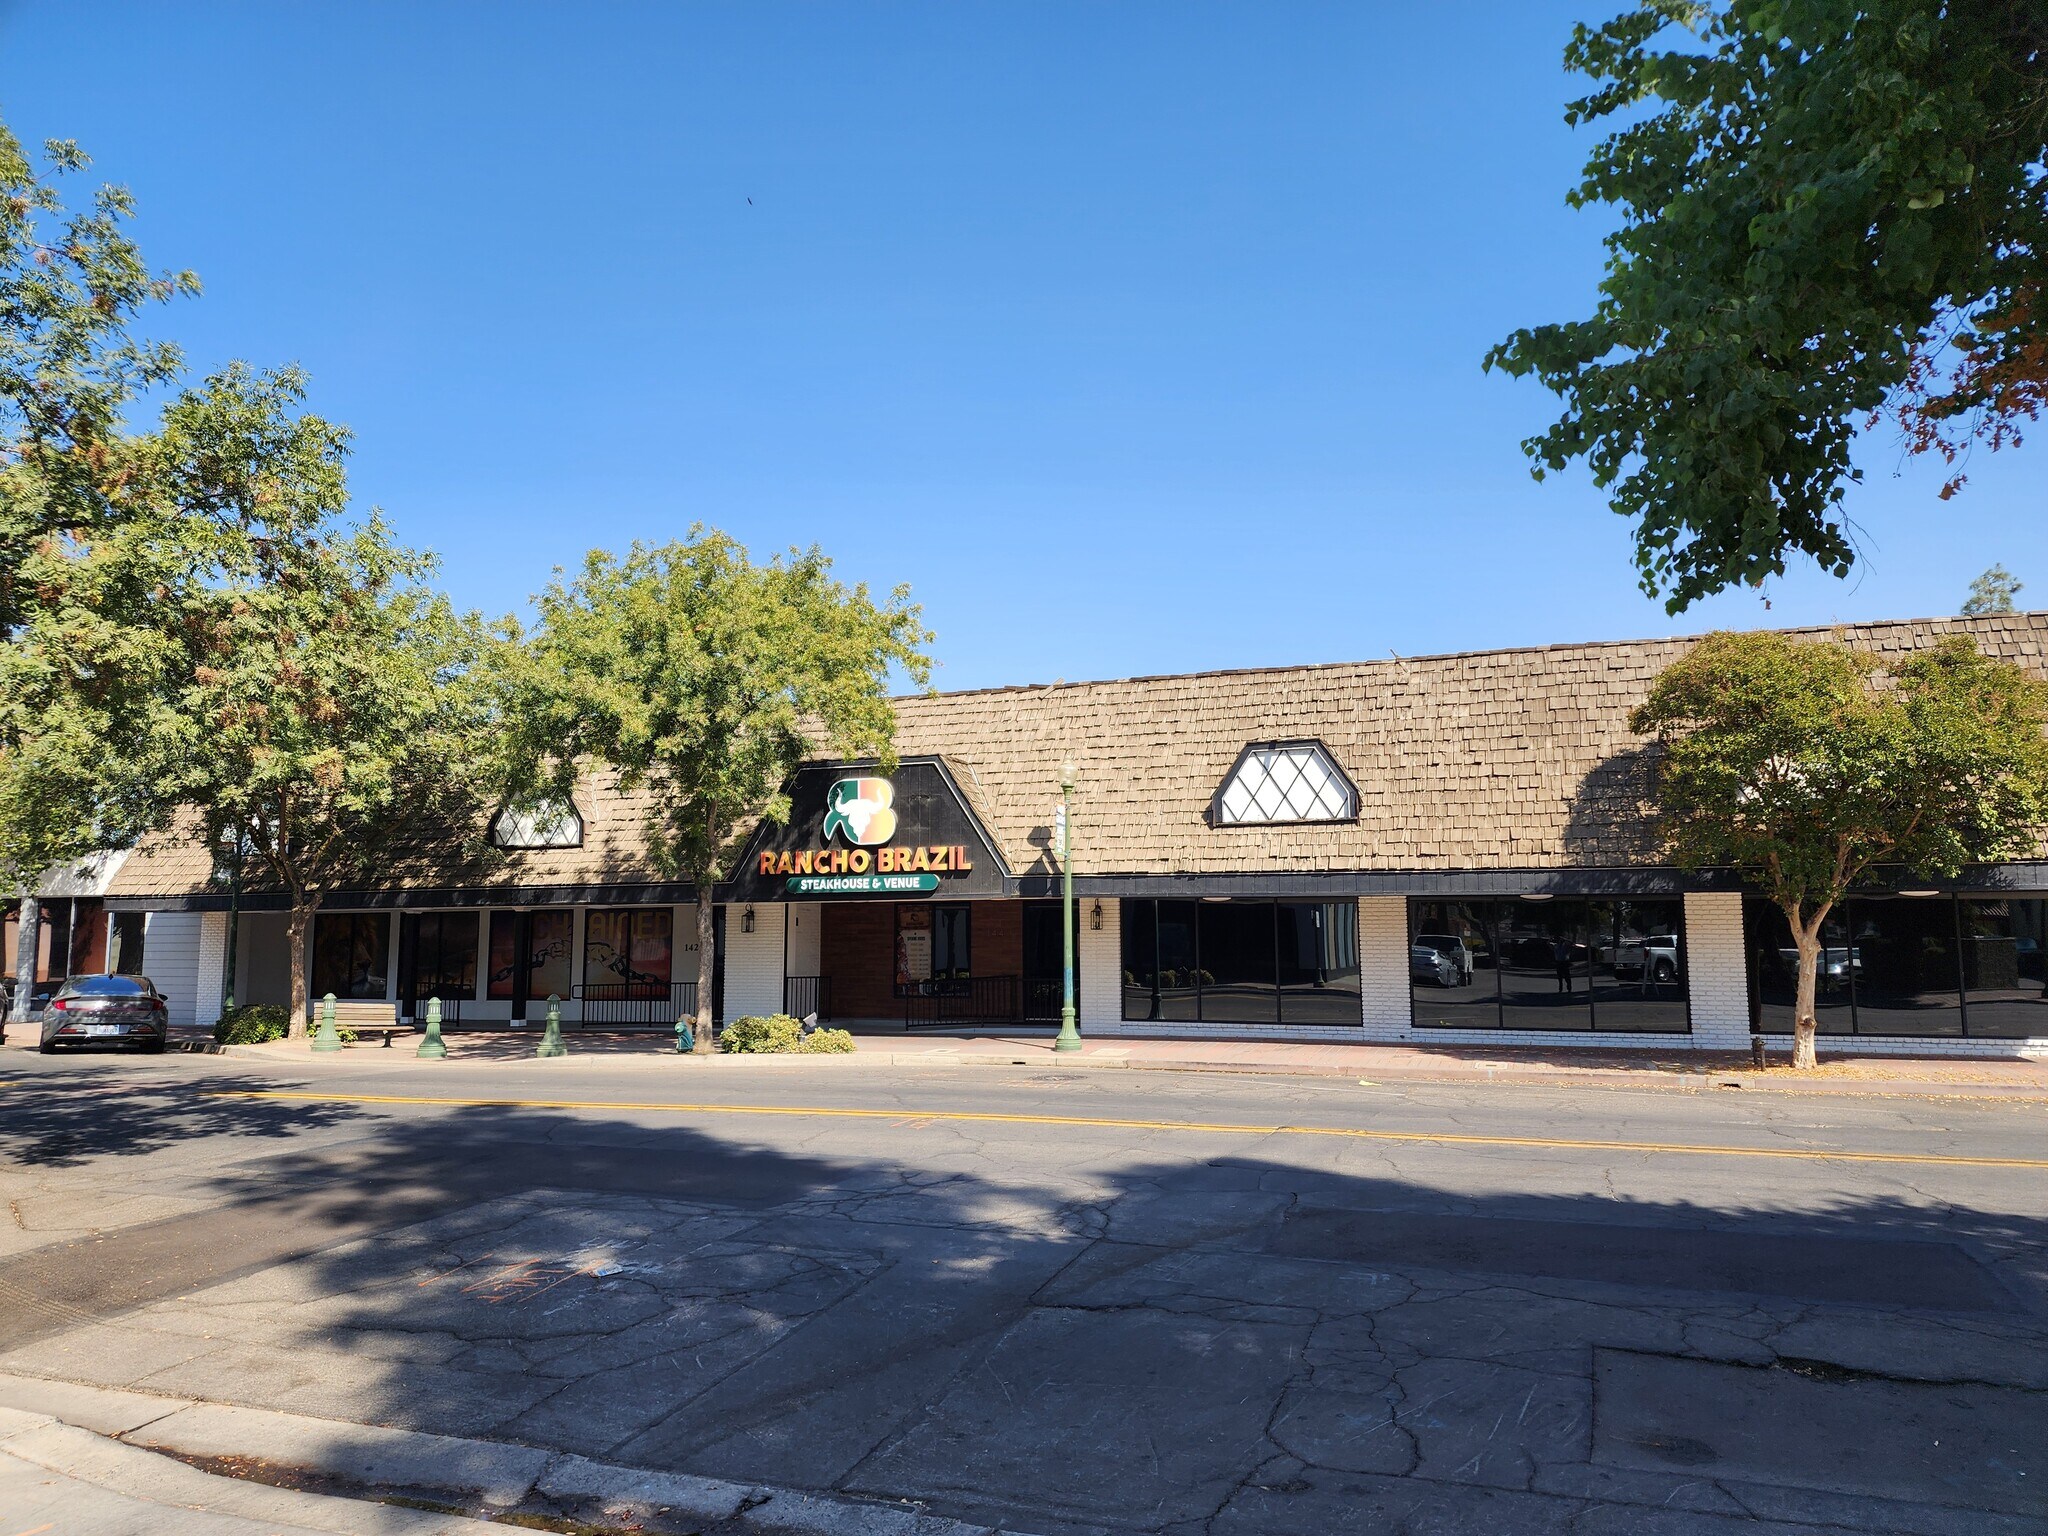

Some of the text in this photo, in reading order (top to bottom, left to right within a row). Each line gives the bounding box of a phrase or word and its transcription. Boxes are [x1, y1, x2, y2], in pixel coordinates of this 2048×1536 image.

[759, 845, 973, 875] RANCHO BRAZIL
[800, 877, 920, 890] STEAKHOUSE & VENUE
